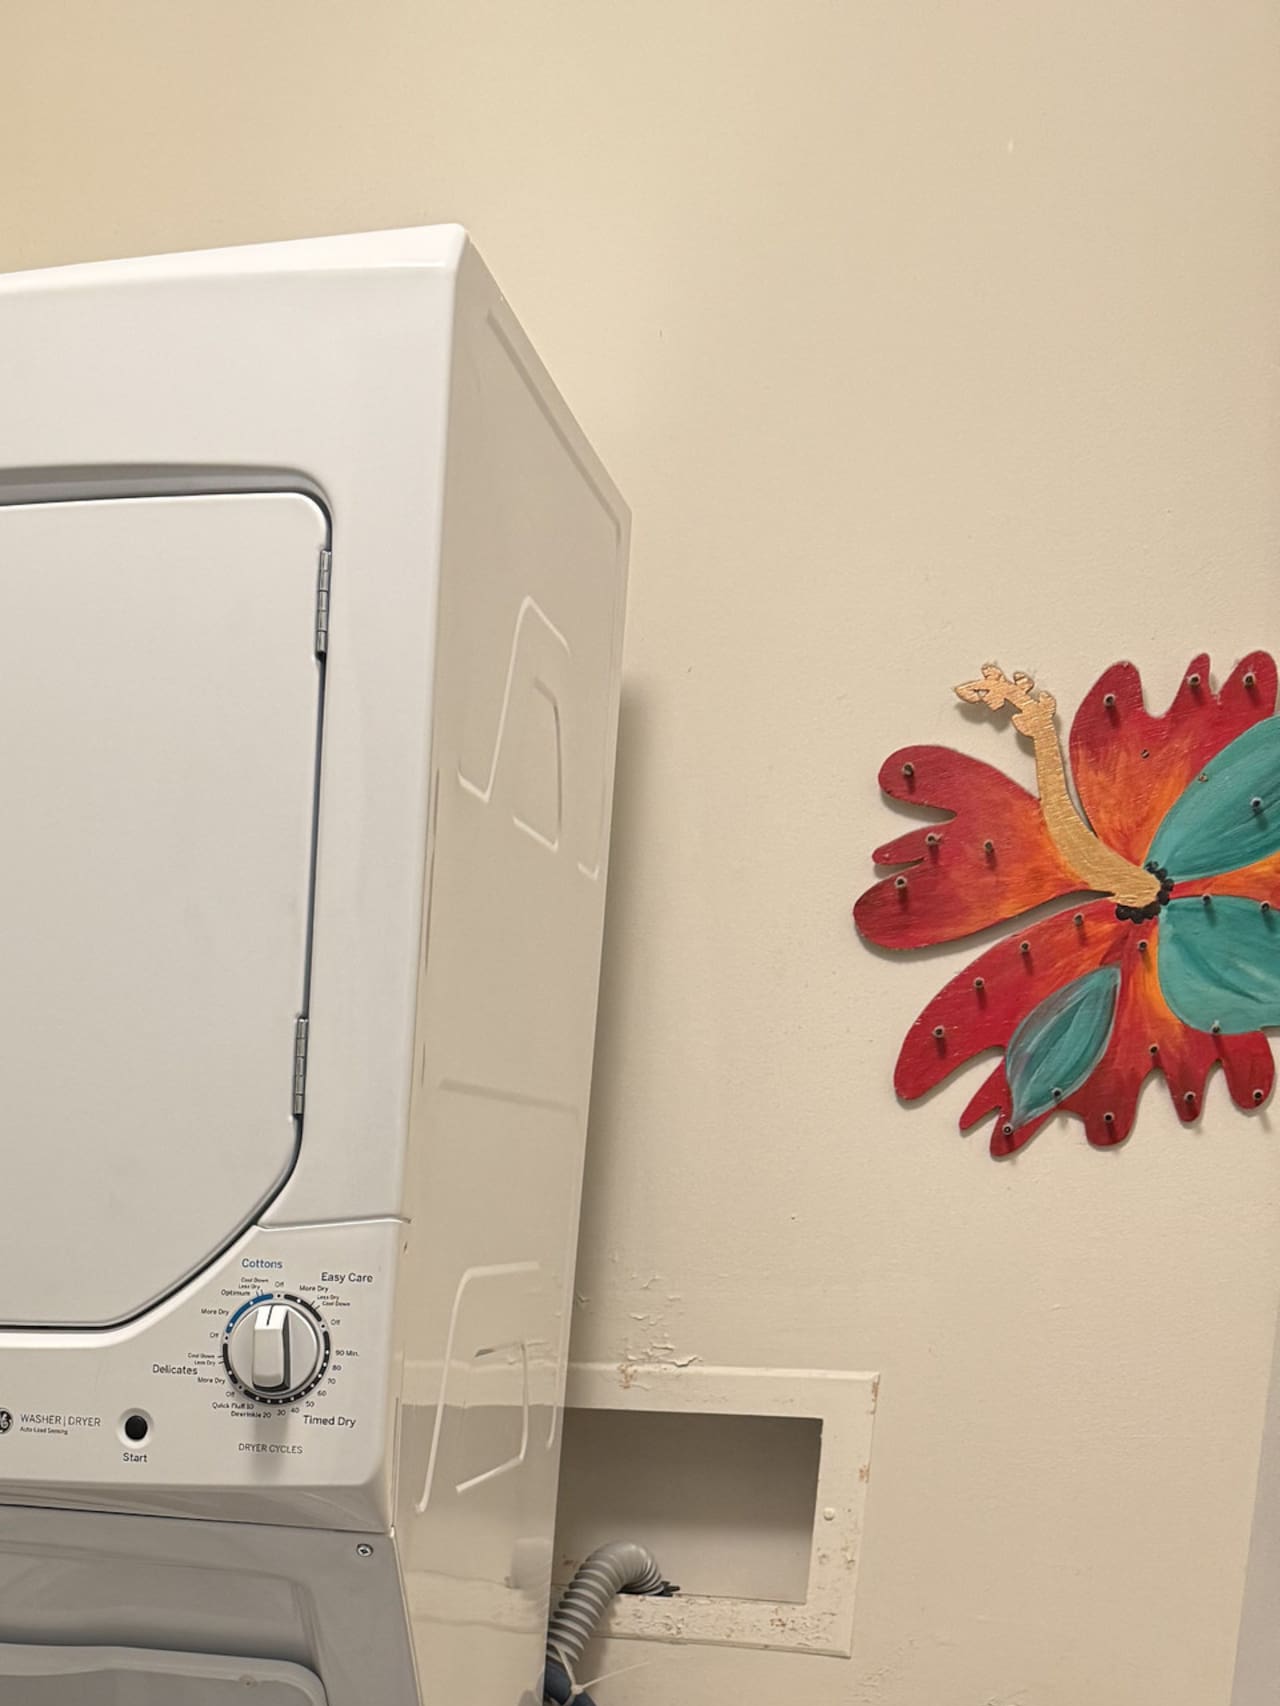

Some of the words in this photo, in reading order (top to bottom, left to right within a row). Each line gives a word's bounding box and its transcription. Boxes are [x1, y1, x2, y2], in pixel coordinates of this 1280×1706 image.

[241, 1258, 283, 1269] Cottons
[320, 1271, 345, 1284] Easy
[348, 1272, 374, 1283] Care
[220, 1289, 251, 1297] Optimum
[317, 1285, 329, 1293] Dry
[218, 1308, 229, 1316] Dry
[152, 1364, 198, 1375] Delicates
[214, 1377, 226, 1385] Dry
[20, 1414, 62, 1425] WASHER
[68, 1416, 101, 1427] DRYER
[262, 1411, 272, 1419] 20
[303, 1415, 335, 1426] Timed
[337, 1416, 357, 1428] Dry
[238, 1443, 268, 1453] DRYER
[268, 1444, 303, 1455] CYCLES
[122, 1452, 148, 1463] Start
